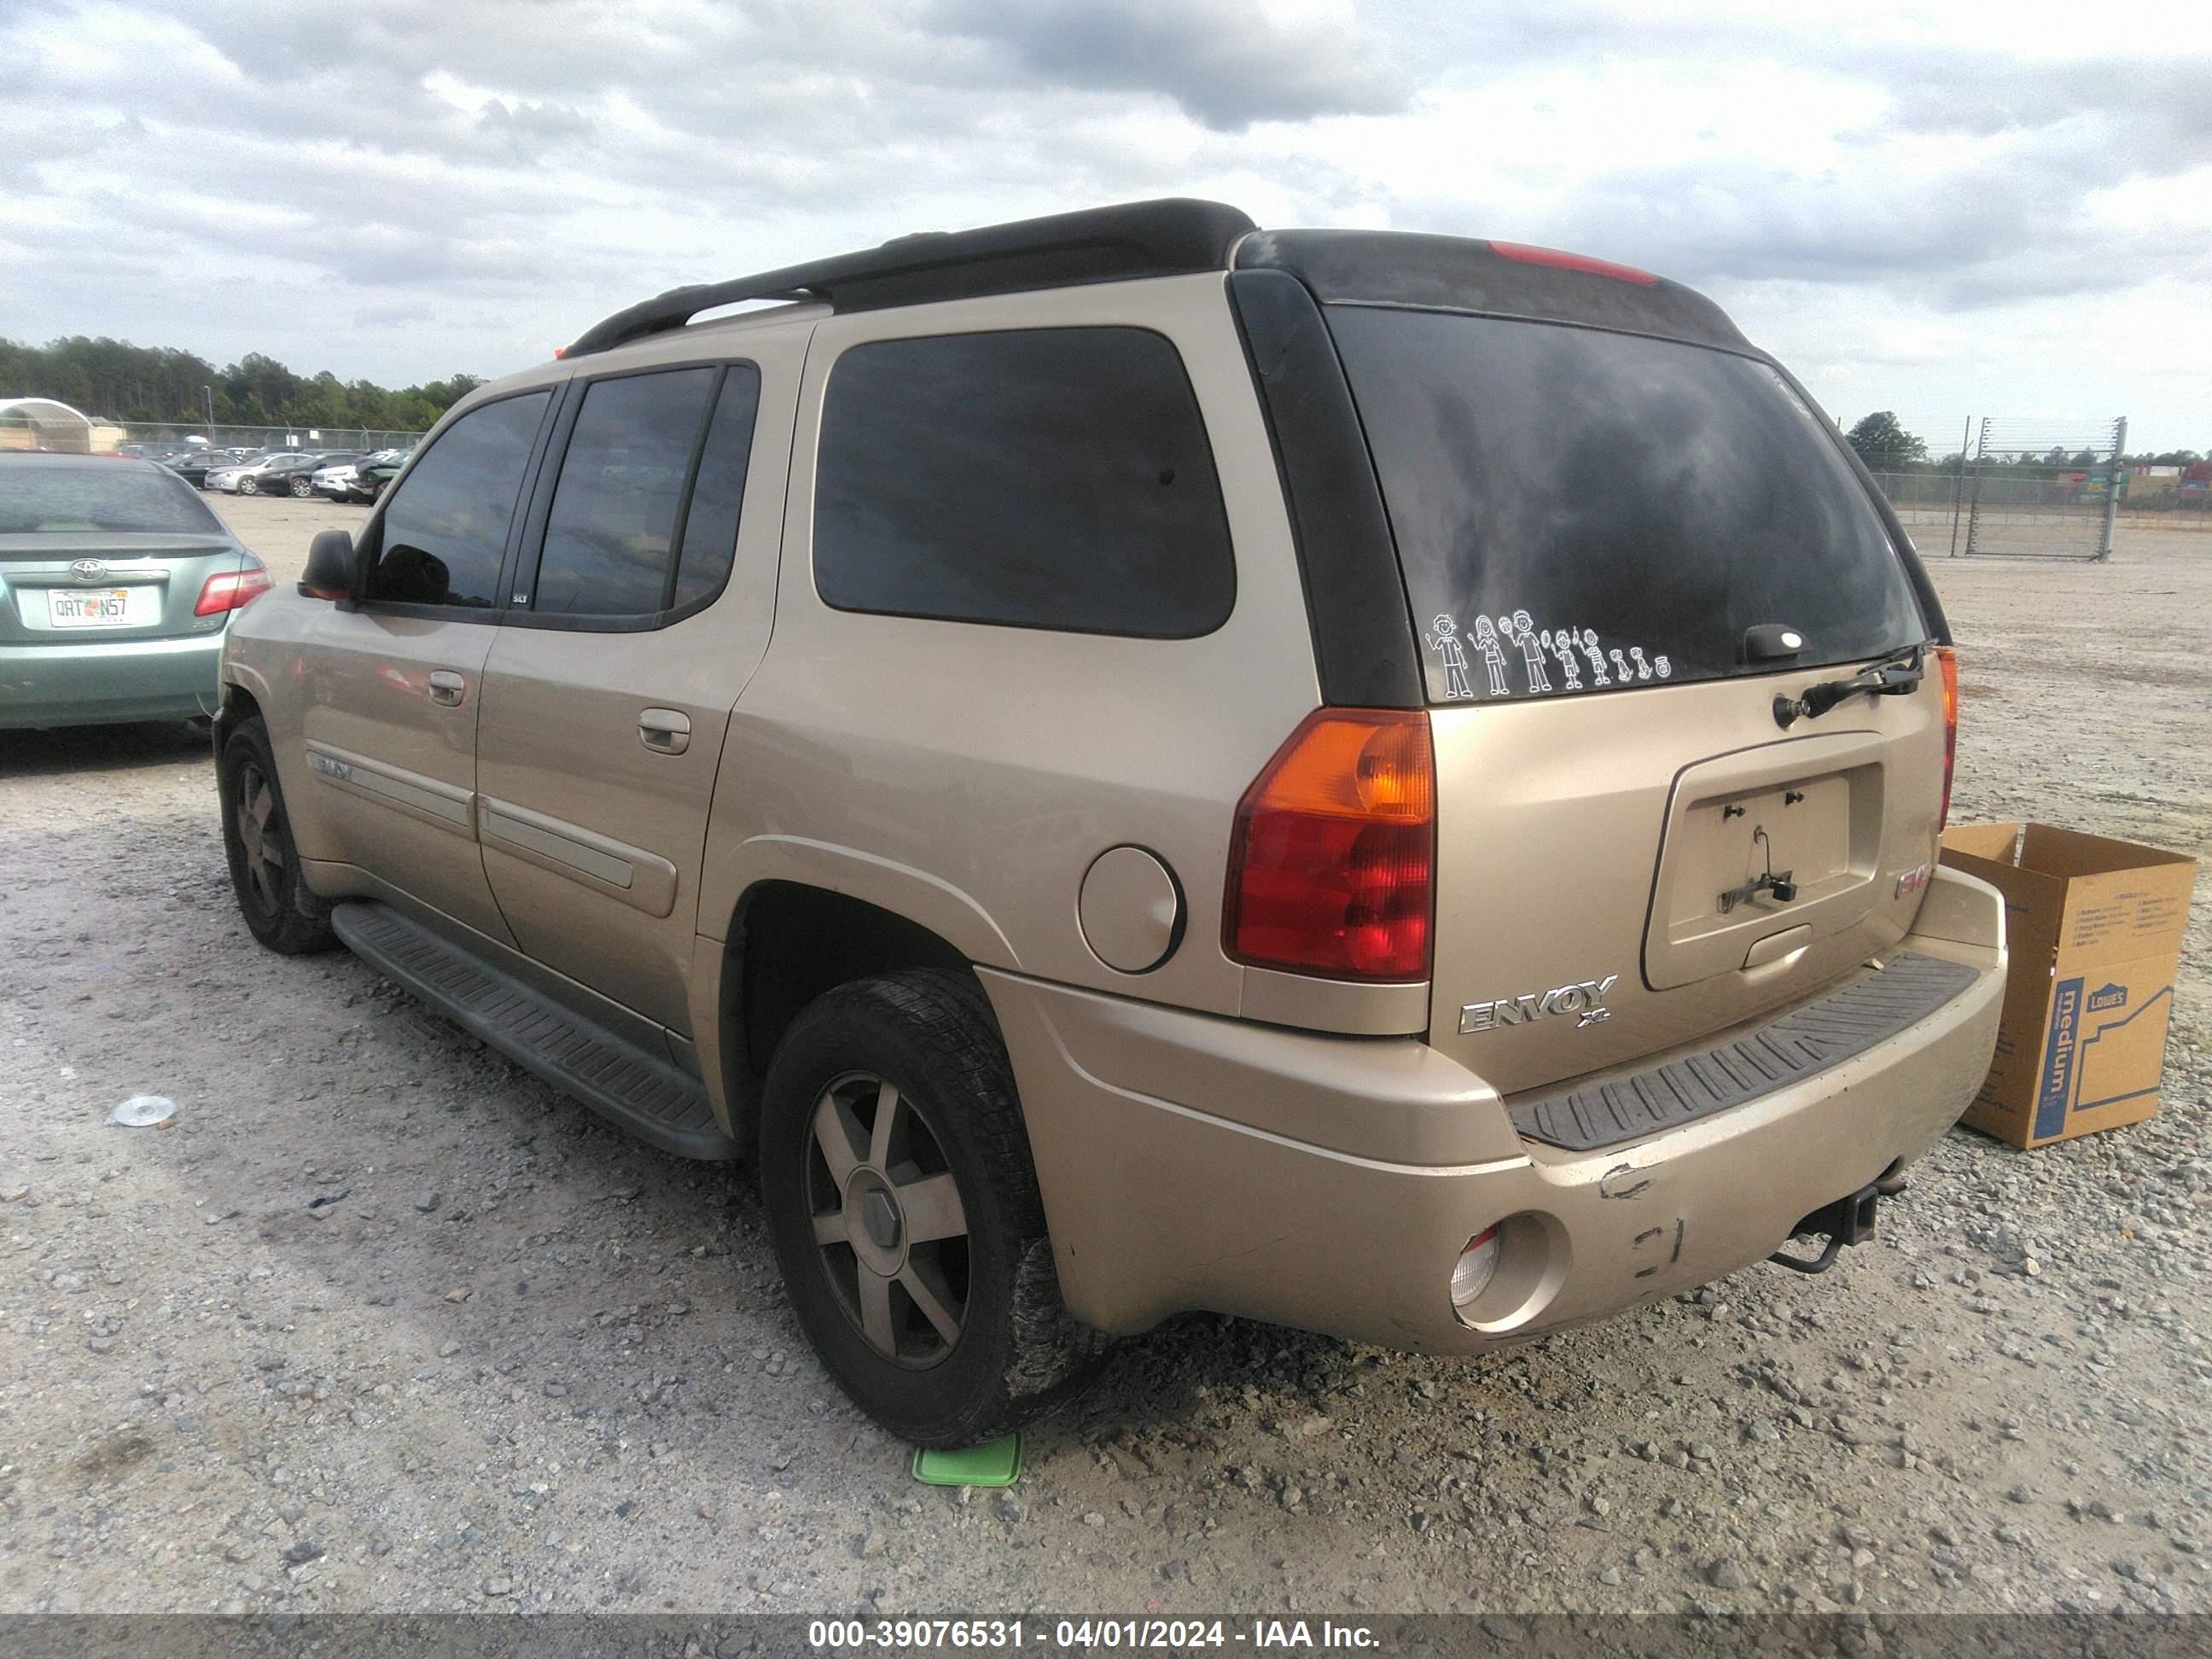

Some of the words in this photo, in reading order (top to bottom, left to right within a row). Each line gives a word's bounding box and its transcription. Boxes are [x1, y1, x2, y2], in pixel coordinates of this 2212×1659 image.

[99, 598, 126, 616] N57
[512, 594, 528, 603] SLT
[1458, 973, 1618, 1035] ENVOY
[2091, 991, 2124, 1010] LOWE'S
[1575, 1007, 1612, 1029] XL
[2050, 989, 2076, 1093] medium
